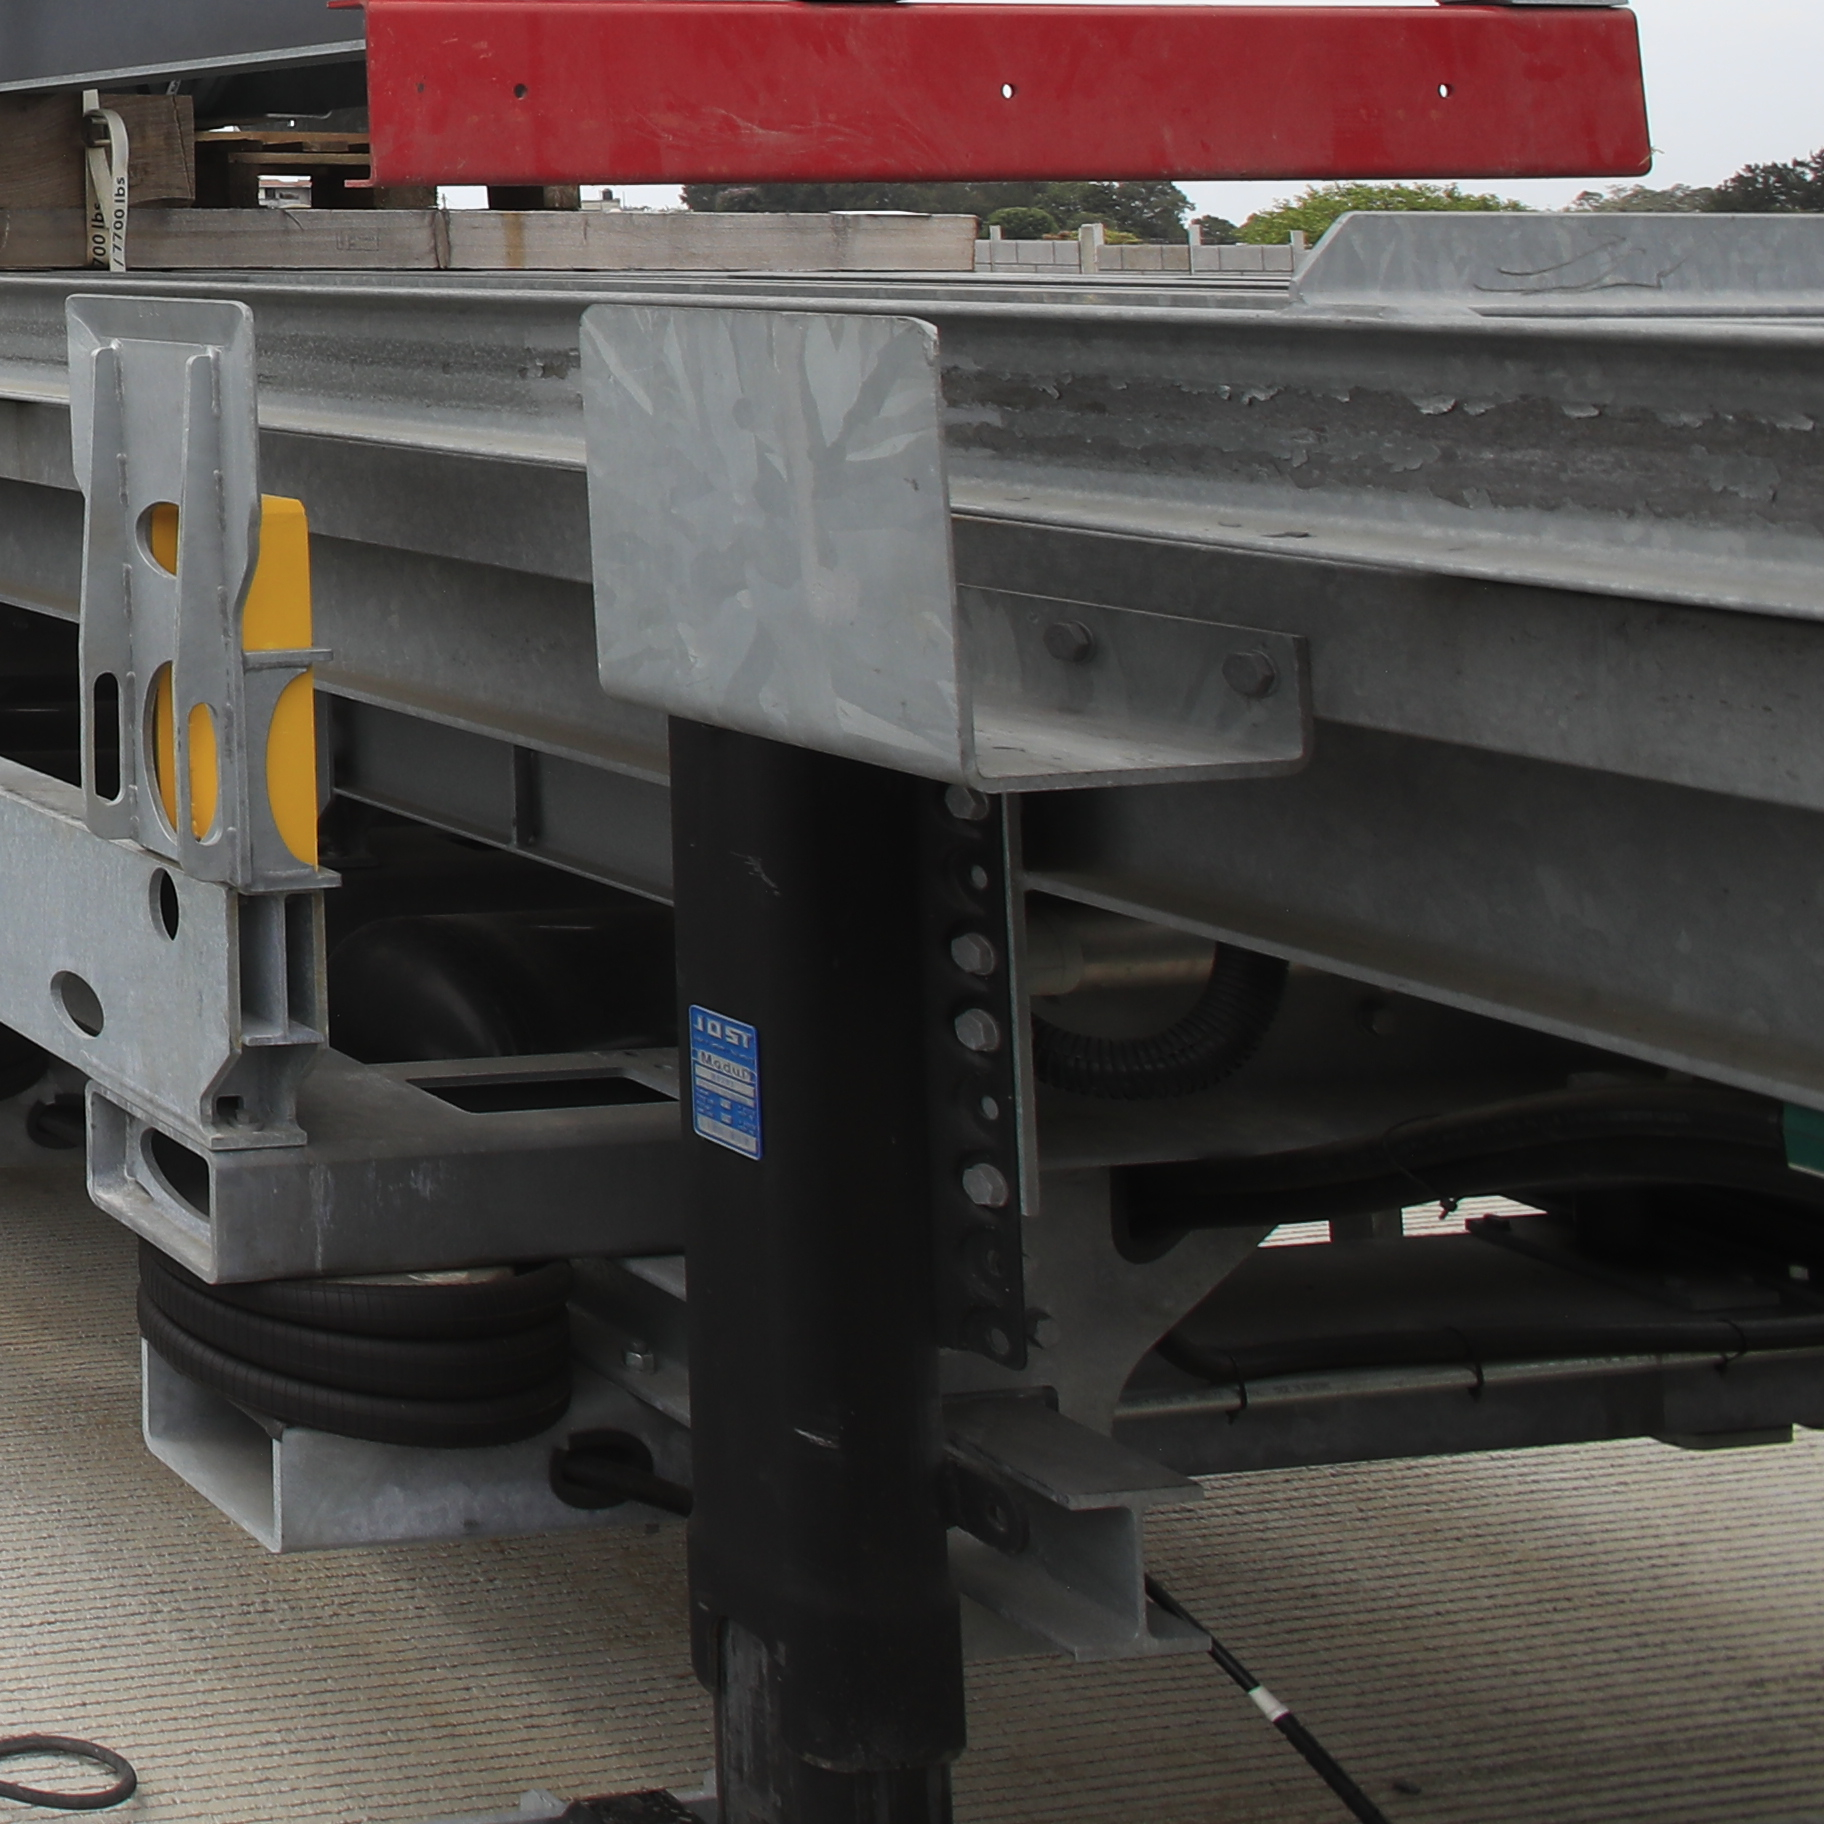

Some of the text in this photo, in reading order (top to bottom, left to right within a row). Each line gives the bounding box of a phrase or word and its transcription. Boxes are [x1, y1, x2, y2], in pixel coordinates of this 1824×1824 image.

[114, 176, 127, 204] lbs
[112, 207, 126, 254] 7700
[693, 1014, 752, 1049] JOST
